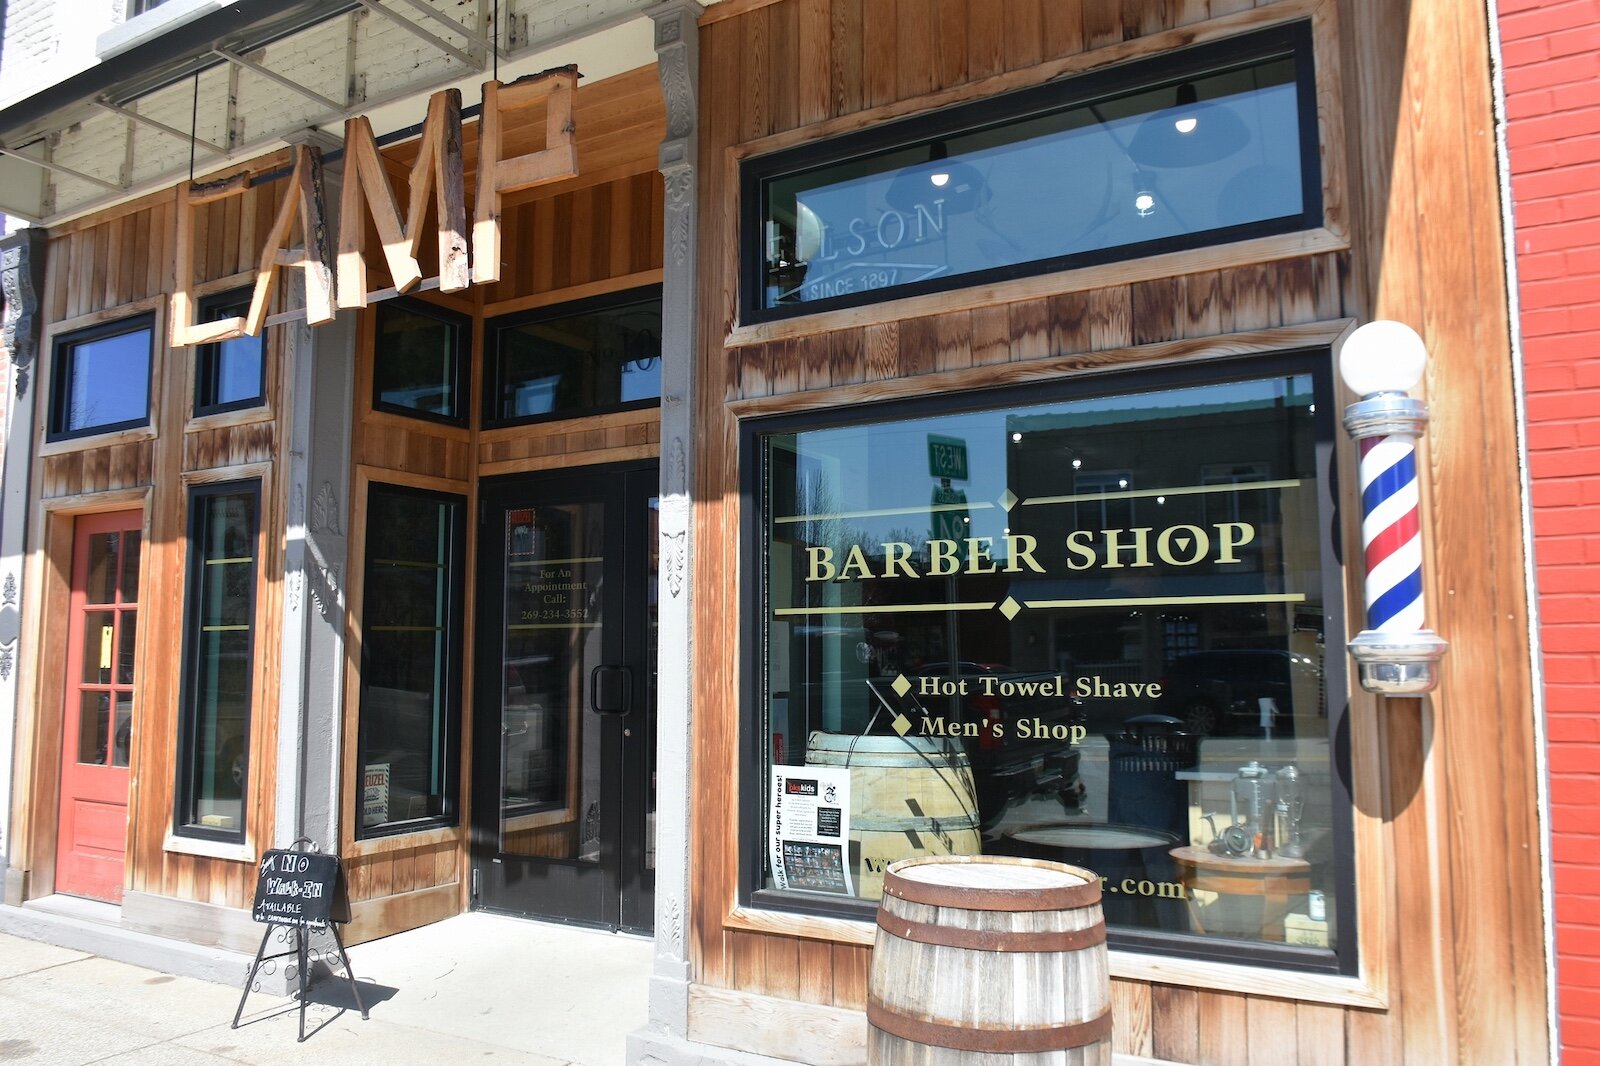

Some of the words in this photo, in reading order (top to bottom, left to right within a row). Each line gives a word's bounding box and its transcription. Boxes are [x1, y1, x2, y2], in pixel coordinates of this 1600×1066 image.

[810, 279, 854, 299] SINCE
[861, 269, 898, 291] 1897
[805, 534, 1047, 583] BARBER
[1066, 521, 1256, 571] SHOP
[540, 569, 555, 579] For
[558, 568, 571, 578] An
[525, 581, 588, 594] Appointment
[543, 594, 567, 604] Call:
[919, 676, 969, 697] Hot
[978, 675, 1065, 698] Towel
[1075, 676, 1163, 699] Shave
[919, 716, 1005, 738] Men's
[1016, 717, 1088, 745] Shop
[775, 775, 783, 810] heroes!
[775, 810, 783, 836] super
[281, 854, 309, 873] NO
[777, 869, 787, 890] Walk
